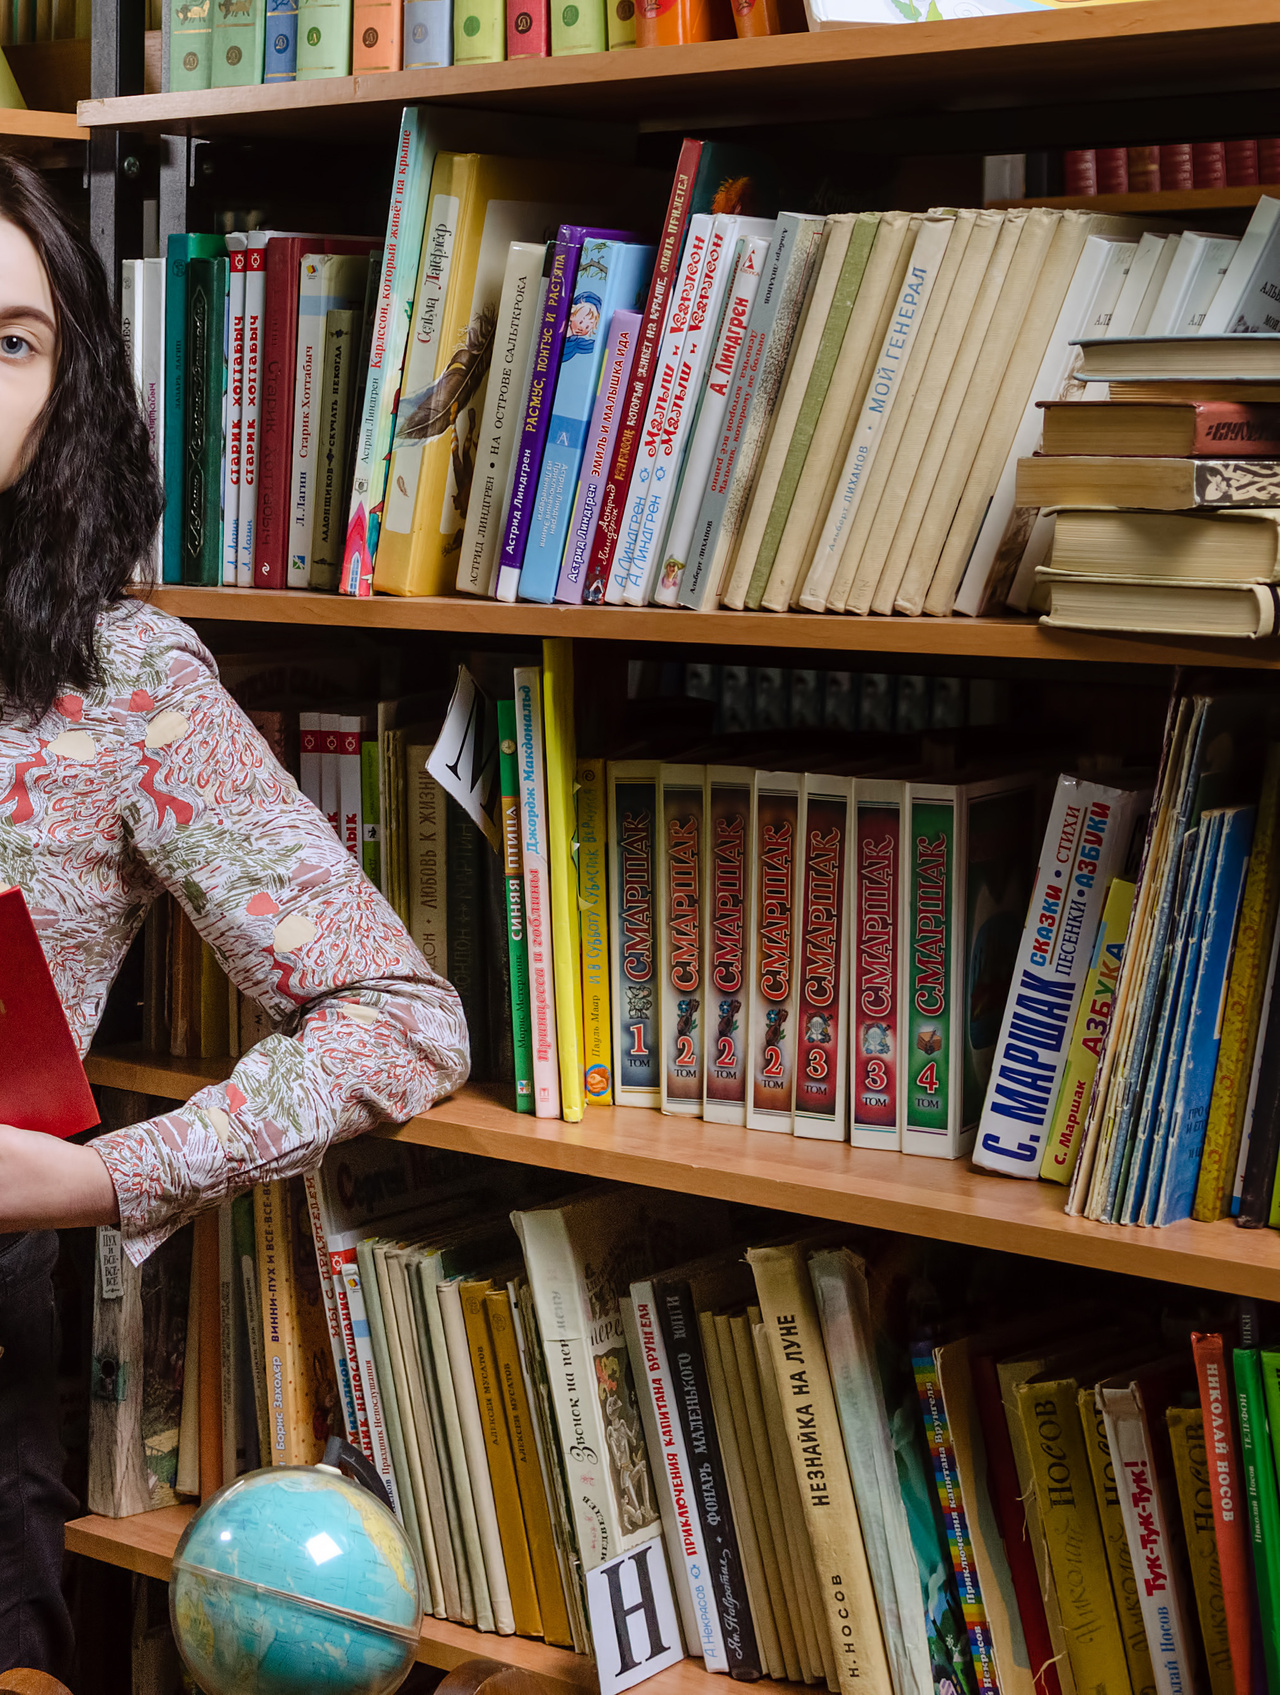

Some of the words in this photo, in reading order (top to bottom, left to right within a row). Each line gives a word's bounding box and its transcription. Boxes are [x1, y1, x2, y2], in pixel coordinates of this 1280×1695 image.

[398, 129, 412, 175] крыше
[389, 198, 403, 240] живёт
[382, 242, 397, 301] который
[424, 222, 453, 291] Лагерлёф
[548, 254, 566, 307] РАСТЯПА
[416, 296, 440, 345] Сельма
[505, 275, 528, 364] САЛЬТКРОКА
[626, 379, 646, 428] КОТОРЫЙ
[667, 173, 689, 235] ПРИЛЕТЕЛ
[232, 316, 244, 407] ХОТТАБЫЧ
[247, 315, 259, 407] ХОТТАБЫЧ
[370, 300, 391, 370] Карлссон,
[536, 327, 555, 373] ПОНТУС
[738, 329, 758, 382] Девочка,
[301, 345, 314, 407] Хоттабыч
[331, 344, 342, 397] НЕКОГДА
[494, 367, 513, 430] ОСТРОВЕ
[843, 444, 869, 504] ЛИХАНОВ
[867, 366, 896, 415] МОЙ
[885, 266, 928, 362] ГЕНЕРАЛ
[299, 408, 310, 459] Старик
[328, 399, 340, 447] СКУЧАТЬ
[364, 376, 380, 433] Линдгрен
[525, 376, 547, 433] РАСМУС,
[230, 419, 241, 486] СТАРИК
[245, 418, 257, 486] СТАРИК
[567, 538, 586, 584] Астрид
[579, 482, 598, 539] Линдгрен
[591, 436, 609, 479] ЭМИЛЬ
[604, 360, 626, 424] МАЛЫШКА
[616, 331, 631, 360] ИДА
[718, 447, 738, 495] Мальчик,
[731, 391, 751, 443] которому
[322, 463, 334, 544] ЛАДОНЩИКОВ
[477, 475, 496, 540] ЛИНДГРЕН
[513, 448, 533, 509] Линдгрен
[543, 461, 561, 520] Приключения
[470, 539, 485, 586] АСТРИД
[505, 508, 523, 556] Астрид
[698, 519, 714, 560] ЛИХАНОВ
[519, 685, 537, 783] Макдональд
[504, 806, 520, 869] ПТИЦА
[524, 787, 541, 855] Джордж
[420, 849, 438, 910] ЛЮБОВЬ
[508, 879, 524, 941] СИНЯЯ
[528, 868, 544, 947] гоблины
[1029, 884, 1063, 968] СКАЗКИ
[1055, 805, 1081, 865] СТИХИ
[1053, 899, 1087, 978] ПЕСЕНКИ
[1072, 801, 1112, 890] АЗБУКИ
[514, 953, 527, 1012] Метерлинк
[533, 967, 550, 1063] Принцесса
[629, 1023, 648, 1055] 1
[1058, 1078, 1086, 1151] Маршак
[1079, 938, 1127, 1059] АЗБУКА
[627, 1057, 651, 1069] ТОМ
[674, 1068, 698, 1079] ТОМ
[677, 1036, 698, 1067] 2
[714, 1069, 738, 1081] ТОМ
[717, 1036, 738, 1067] 2
[763, 1045, 784, 1077] 2
[806, 1048, 829, 1079] 3
[865, 1059, 888, 1091] 3
[916, 1061, 939, 1094] 4
[990, 968, 1077, 1125] МАРШАК
[761, 1079, 785, 1091] ТОМ
[804, 1084, 828, 1096] ТОМ
[863, 1096, 888, 1108] ТОМ
[915, 1097, 940, 1110] ТОМ
[305, 1175, 332, 1283] ПРИЯТЕЛЕМ
[267, 1267, 280, 1342] ВИННИ-ПУХ
[337, 1291, 367, 1420] НЕПОСЛУШАНИЯ
[638, 1303, 661, 1372] ВРУНГЕЛЯ
[775, 1313, 803, 1368] ЛУНЕ
[271, 1355, 285, 1410] Заходер
[338, 1357, 361, 1446] Михалков
[364, 1359, 384, 1425] Непослушания
[653, 1377, 676, 1448] КАПИТАНА
[678, 1352, 710, 1455] МАЛЕНЬКОГО
[790, 1371, 811, 1398] НА
[1206, 1362, 1230, 1455] НИКОЛАЙ
[273, 1411, 286, 1451] Борис
[376, 1425, 391, 1475] Праздник
[570, 1397, 598, 1465] Звонок
[795, 1403, 831, 1507] НЕЗНАЙКА
[1034, 1399, 1077, 1510] НОСОВ
[666, 1452, 697, 1556] ПРИКЛЮЧЕНИЯ
[701, 1461, 721, 1526] ФОНАРЬ
[1215, 1460, 1235, 1522] НОСОВ
[949, 1509, 976, 1605] Приключения
[1124, 1459, 1167, 1597] Тук-Тук-Тук!
[600, 1545, 671, 1679] Н
